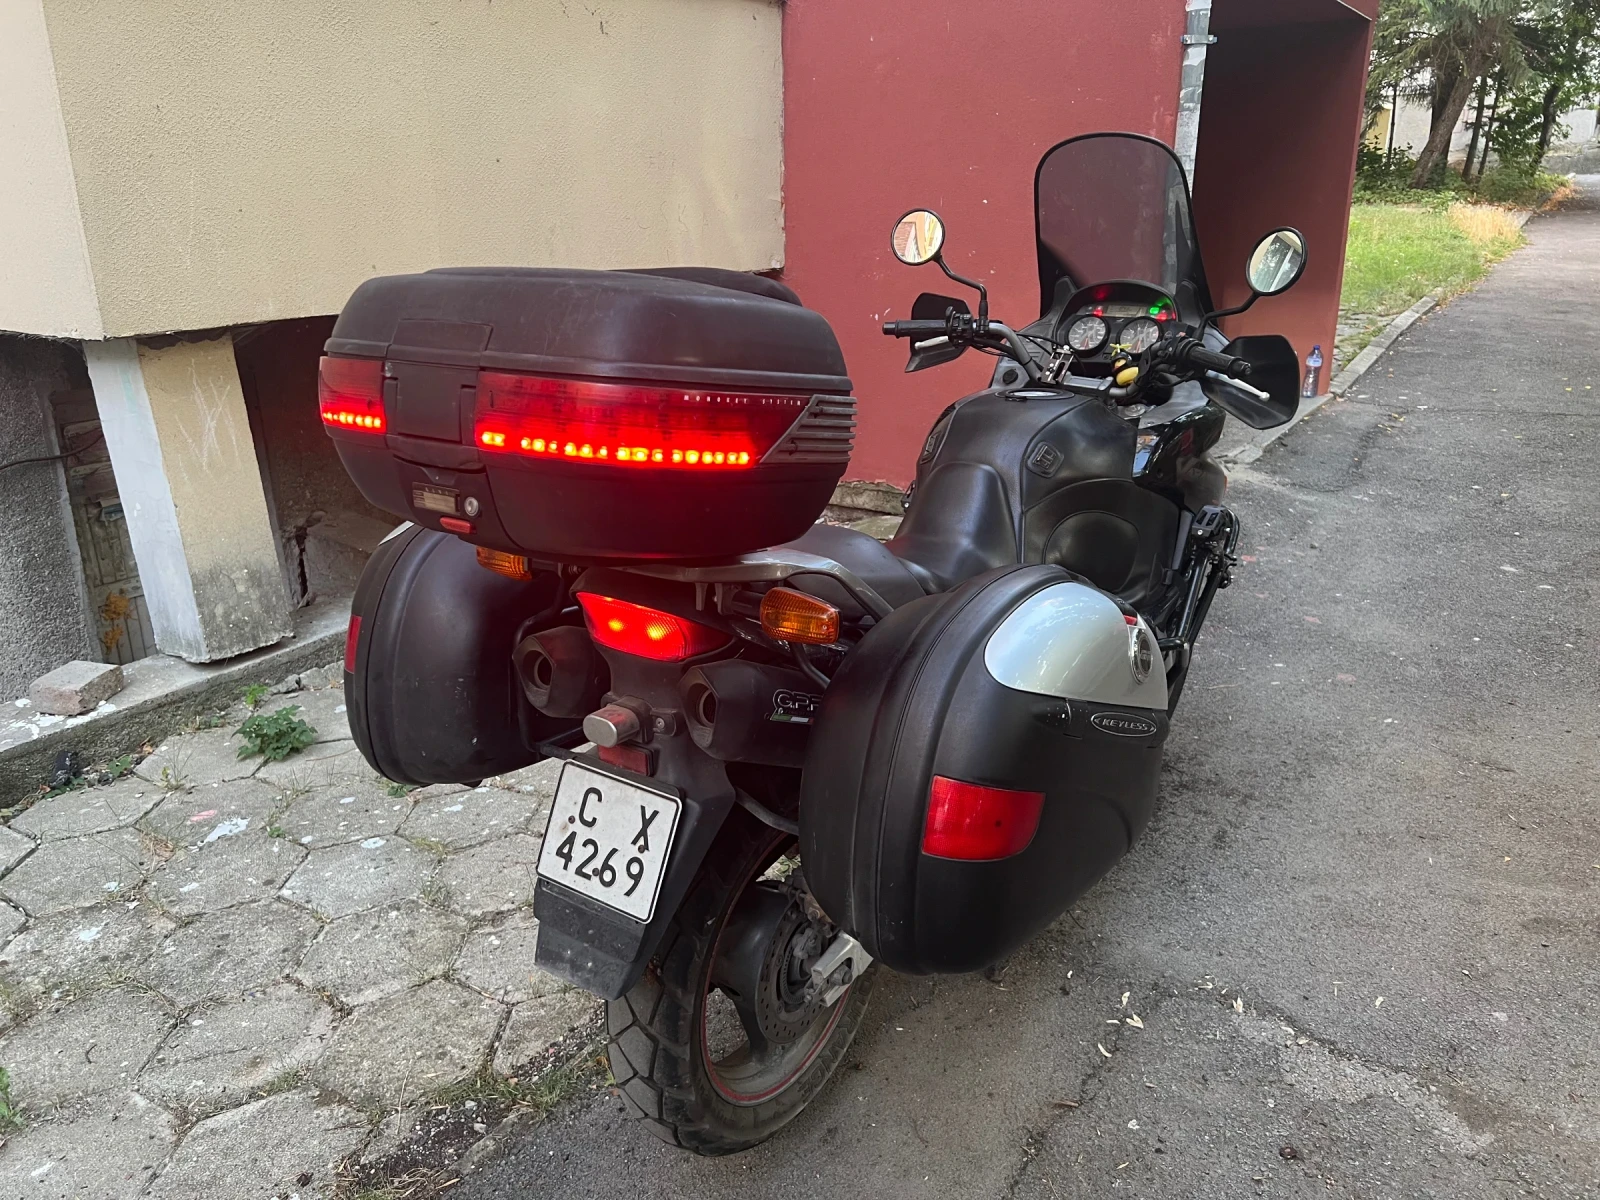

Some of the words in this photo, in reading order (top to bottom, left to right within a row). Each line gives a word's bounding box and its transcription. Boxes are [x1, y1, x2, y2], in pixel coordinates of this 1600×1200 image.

[1102, 719, 1148, 731] KEYLESS
[578, 787, 603, 828] C
[630, 805, 660, 852] X
[555, 830, 645, 897] 4269
